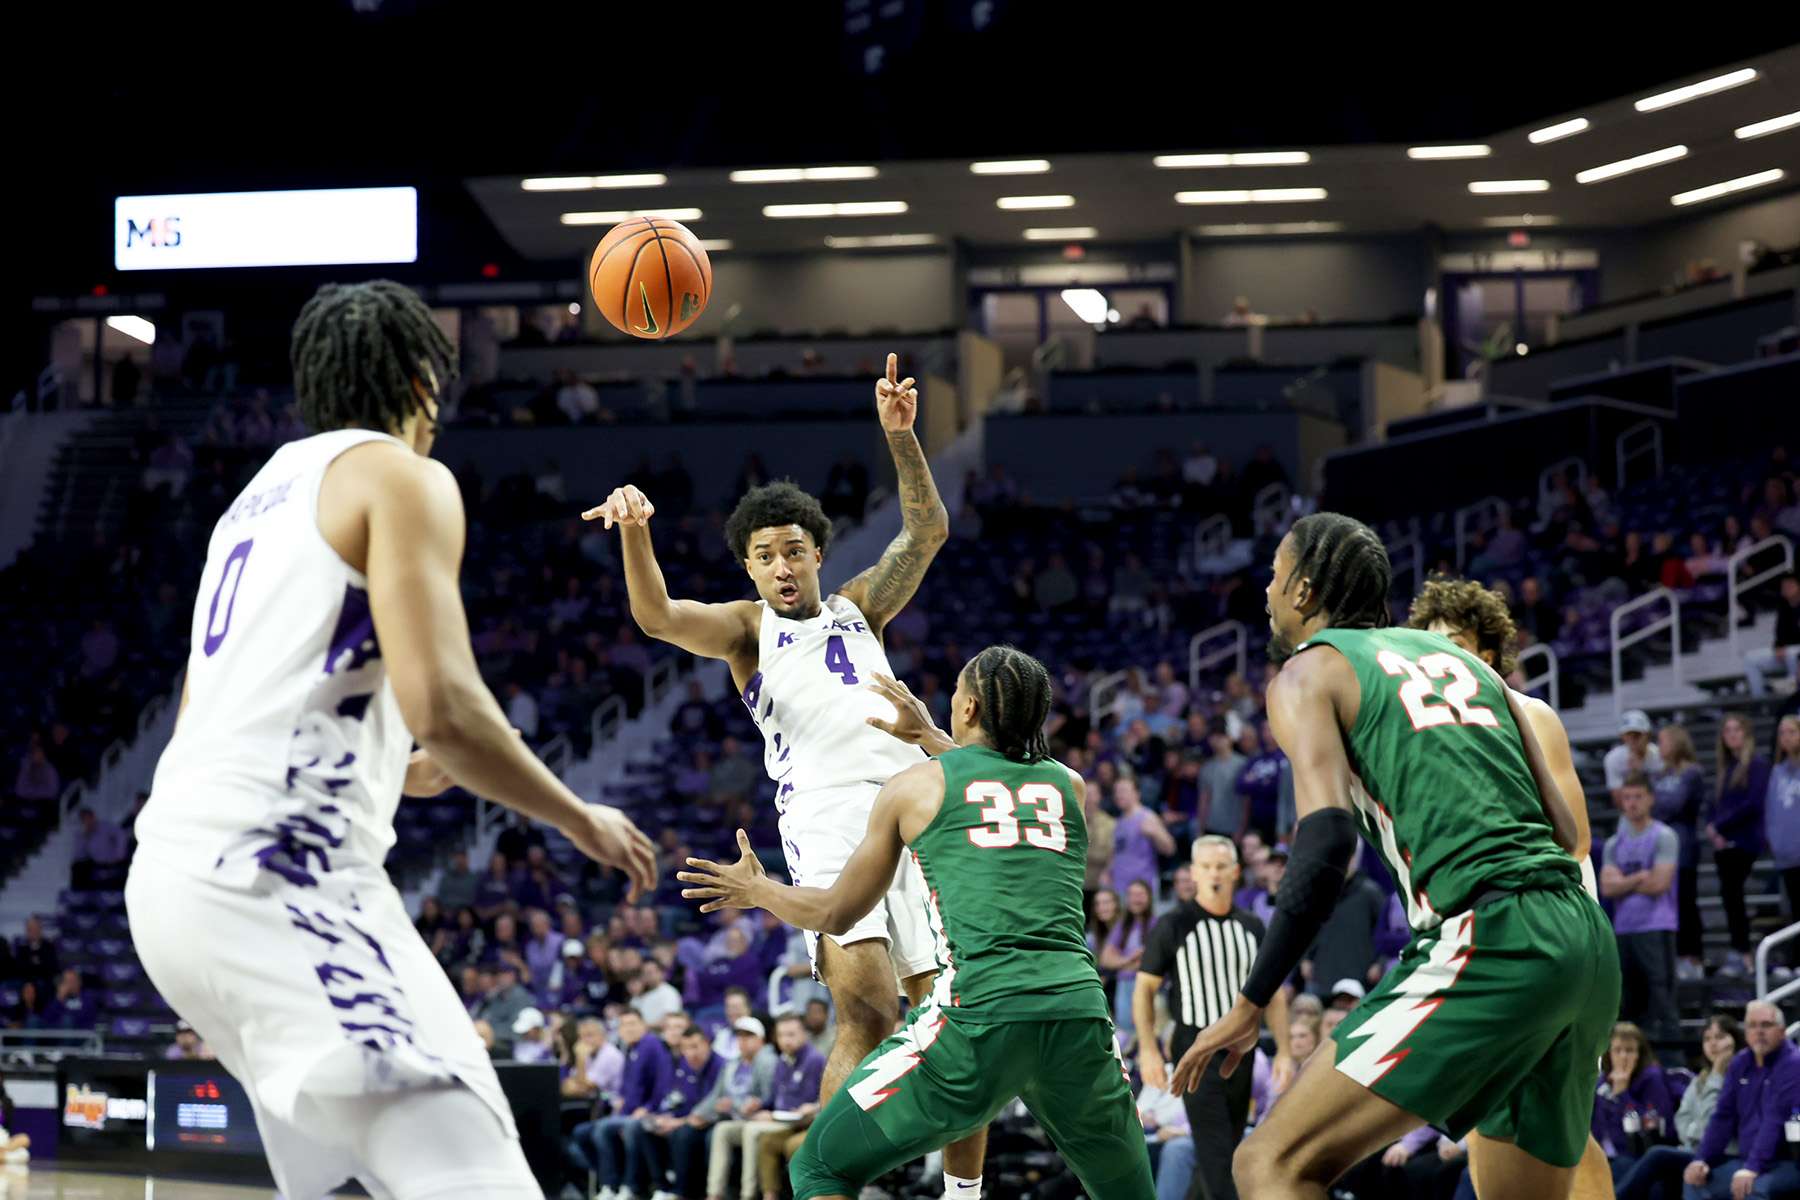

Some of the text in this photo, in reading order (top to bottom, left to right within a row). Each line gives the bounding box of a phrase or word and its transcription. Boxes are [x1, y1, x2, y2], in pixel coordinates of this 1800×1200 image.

[203, 537, 254, 658] 0
[824, 635, 859, 685] 4
[1376, 649, 1500, 732] 22
[964, 780, 1068, 852] 33
